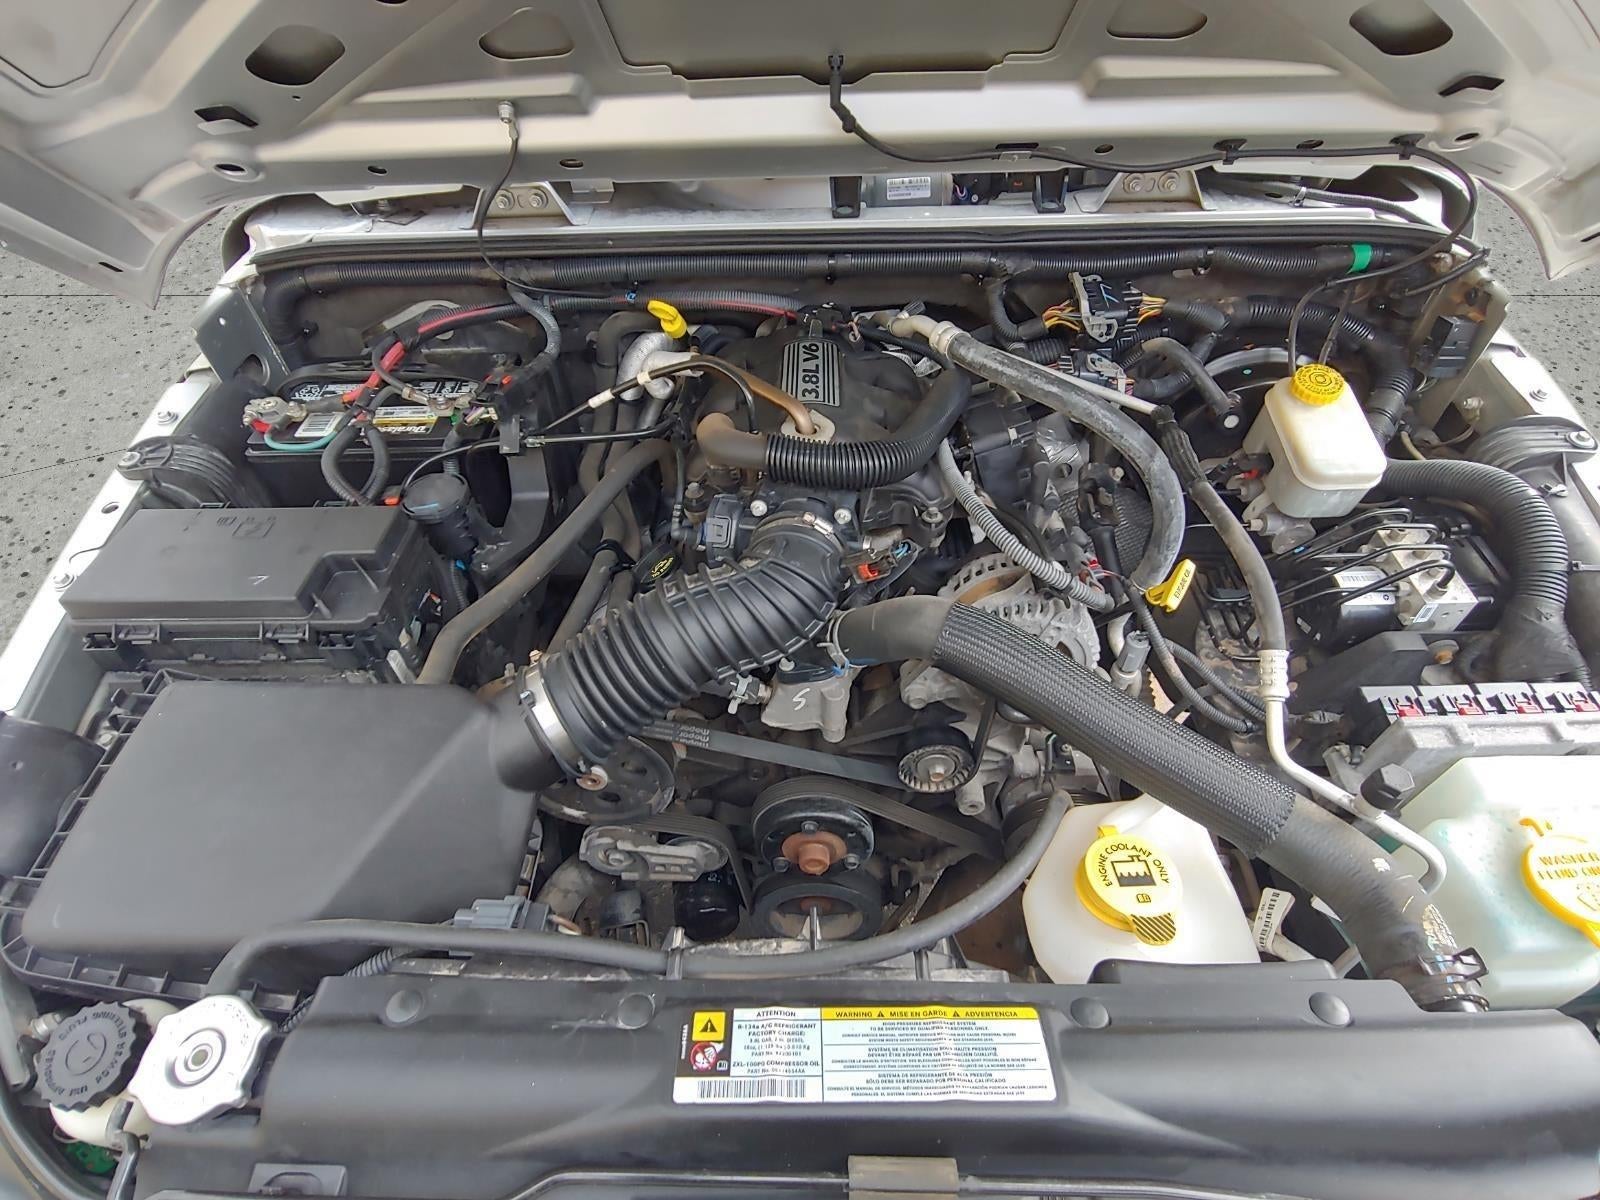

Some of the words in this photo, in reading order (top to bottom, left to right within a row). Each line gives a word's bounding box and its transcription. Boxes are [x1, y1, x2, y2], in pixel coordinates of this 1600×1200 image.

[802, 342, 820, 362] V6
[802, 364, 820, 399] 3.8L
[1098, 853, 1112, 886] ENGINE
[1105, 843, 1152, 858] COOLANT
[1153, 859, 1170, 884] ONLY
